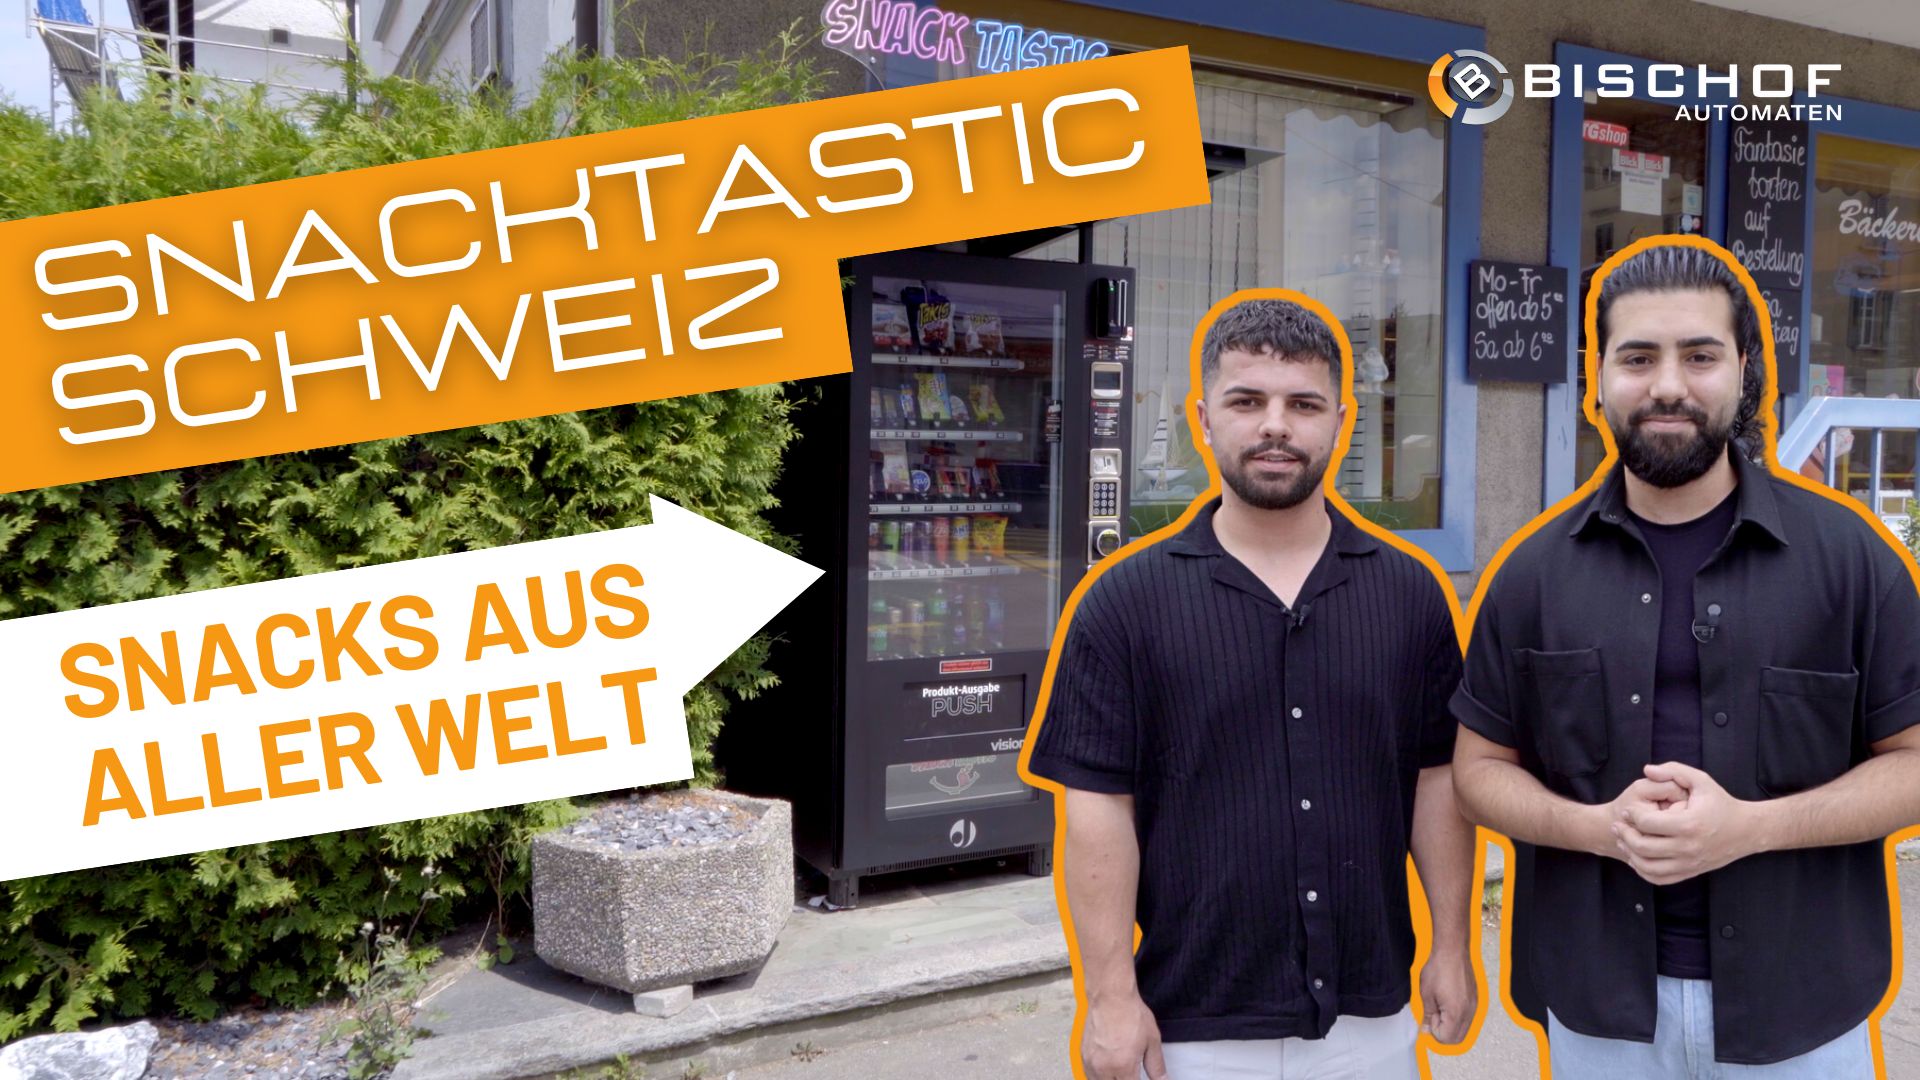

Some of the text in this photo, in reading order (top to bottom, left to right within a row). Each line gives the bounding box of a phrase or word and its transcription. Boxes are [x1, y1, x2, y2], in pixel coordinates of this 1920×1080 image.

[825, 0, 969, 64] SNACK
[1735, 126, 1805, 166] Fantasie
[1744, 202, 1771, 239] auf
[1838, 199, 1920, 243] Bäcker
[1732, 238, 1804, 287] Bestellung
[1476, 292, 1517, 329] offen
[1518, 294, 1539, 321] ab
[1474, 331, 1499, 359] Sa
[1503, 329, 1525, 359] ab
[922, 682, 1000, 698] Produkt-Ausgabe
[931, 693, 993, 718] PUSH
